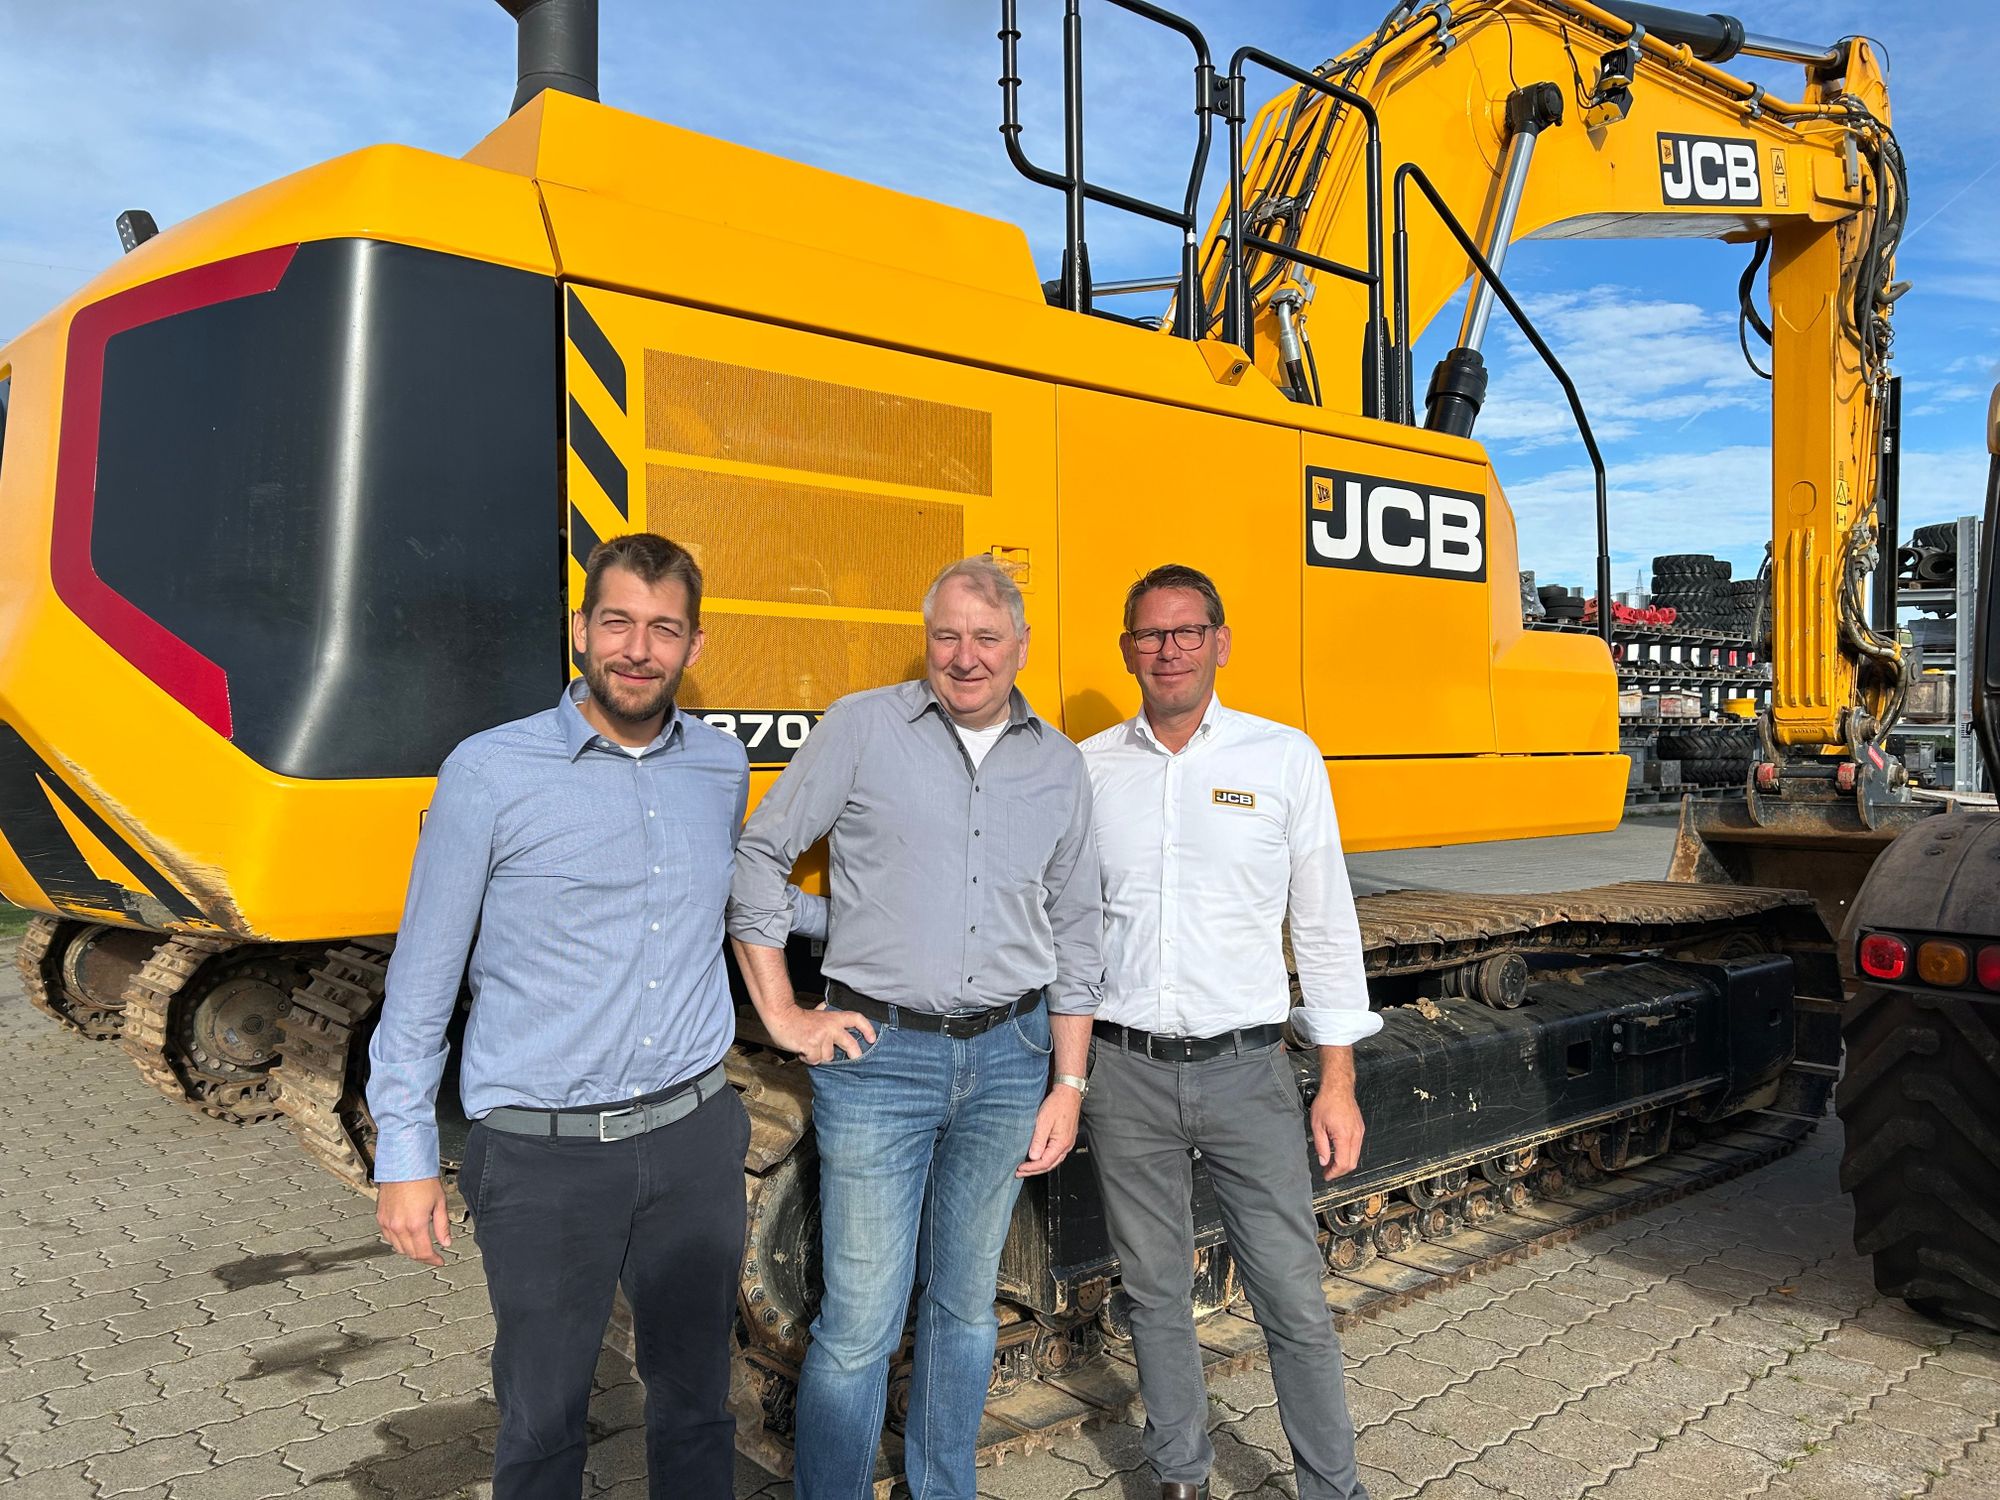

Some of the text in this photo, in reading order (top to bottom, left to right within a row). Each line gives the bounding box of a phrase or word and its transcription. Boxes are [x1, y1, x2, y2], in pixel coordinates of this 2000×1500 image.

[1663, 140, 1760, 200] JCB
[1312, 481, 1483, 573] JCB
[1216, 792, 1253, 805] JCB
